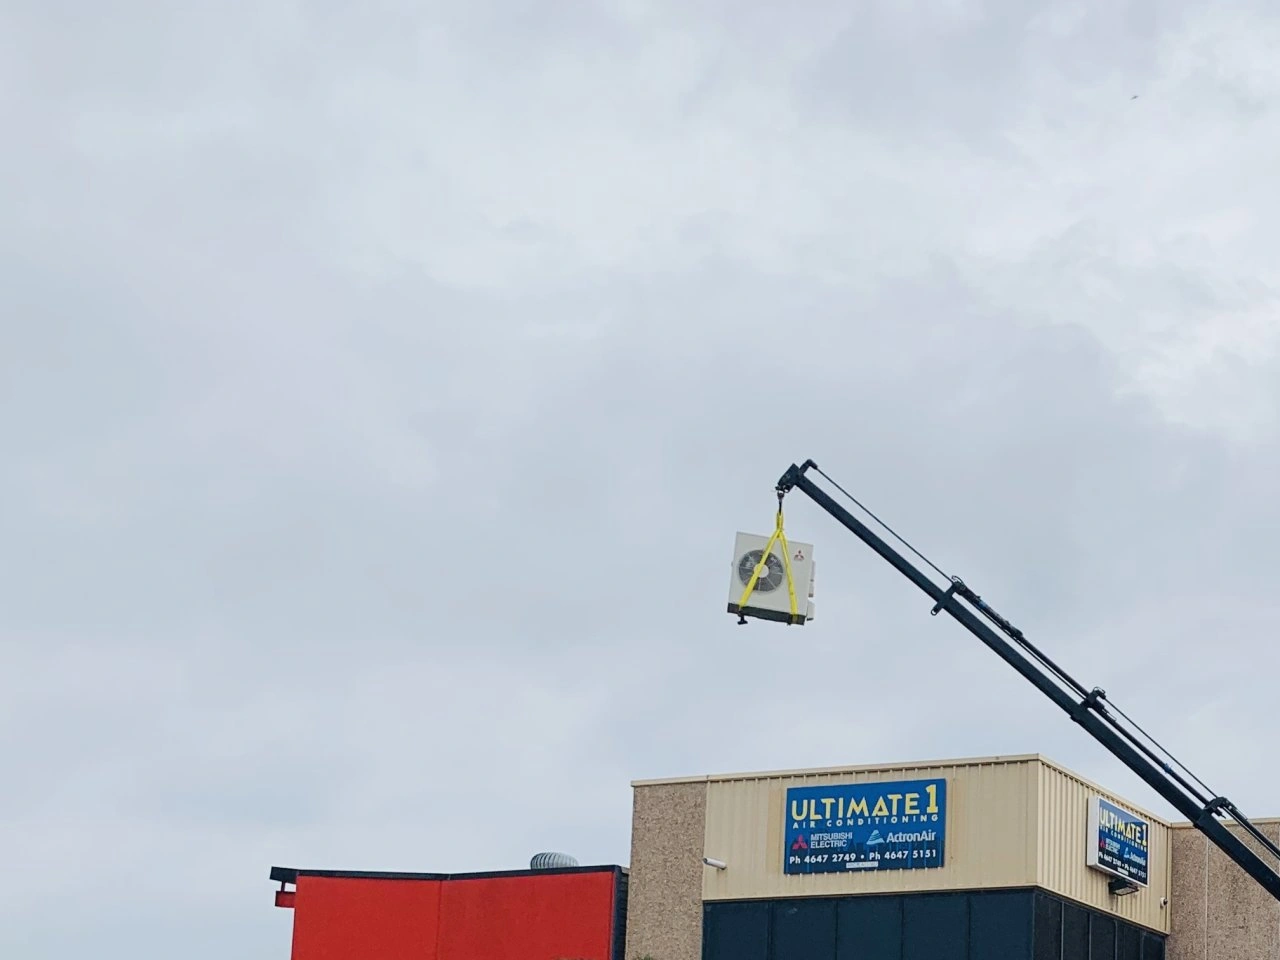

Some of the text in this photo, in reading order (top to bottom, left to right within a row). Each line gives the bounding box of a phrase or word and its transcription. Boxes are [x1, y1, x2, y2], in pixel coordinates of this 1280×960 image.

[791, 793, 920, 821] ULTIMATE
[792, 814, 939, 829] AIR CONDITIONING
[1100, 806, 1141, 844] ULTIMATE
[810, 832, 853, 841] MITSUBISHI
[886, 829, 937, 843] ActronAir
[810, 839, 847, 849] ELECTRIC
[789, 849, 936, 864] Ph 4647 2749 Ph 4647 5151
